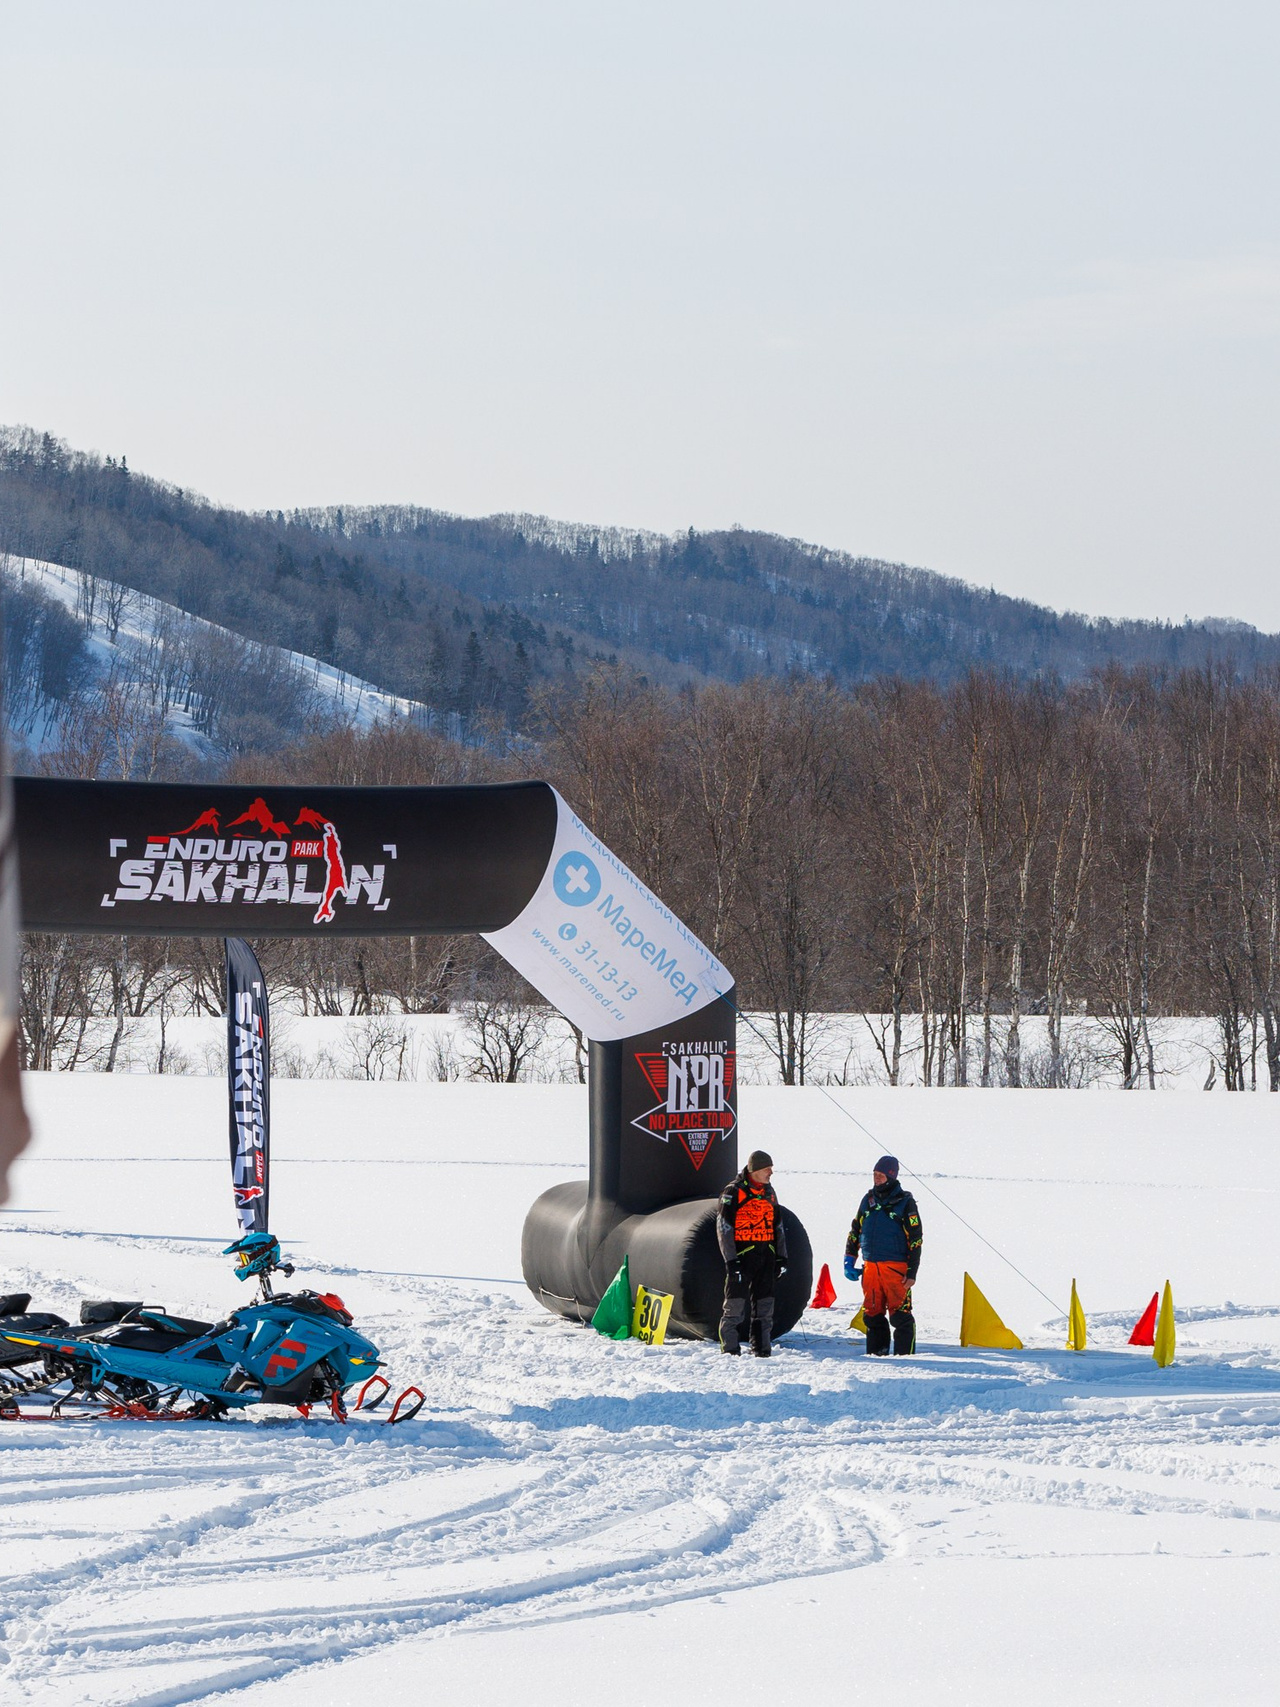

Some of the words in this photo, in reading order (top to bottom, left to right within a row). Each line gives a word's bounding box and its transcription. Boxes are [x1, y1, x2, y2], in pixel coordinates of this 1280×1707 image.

[144, 836, 288, 862] ENDURO
[294, 841, 320, 856] PARK
[575, 941, 638, 1002] 31-13-13
[596, 894, 699, 1006] МареМед
[531, 927, 626, 1022] www.maremed.ru
[670, 1041, 723, 1056] SAKHALIN
[667, 1054, 724, 1113] NPR
[649, 1114, 666, 1130] NO
[670, 1112, 704, 1129] PLACE
[707, 1112, 718, 1128] TO
[720, 1112, 733, 1128] RUN
[639, 1295, 662, 1331] 30
